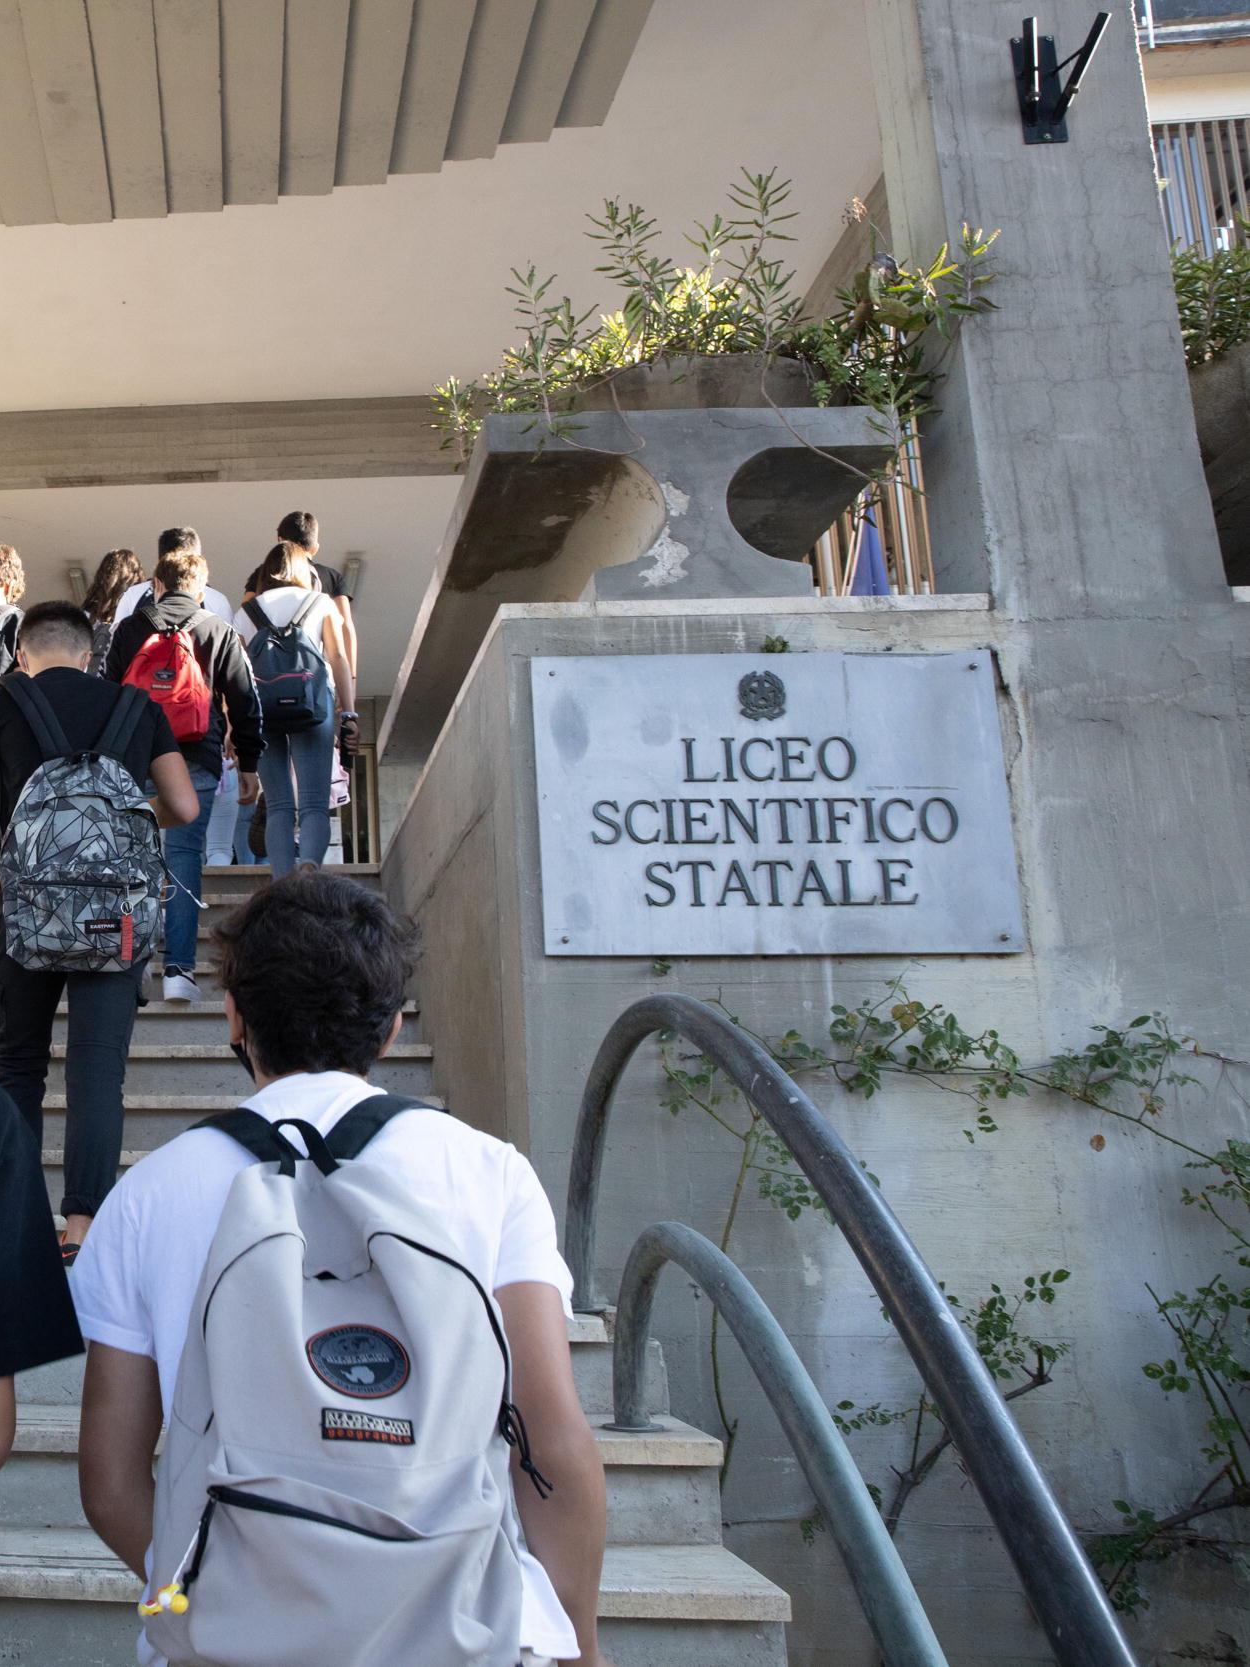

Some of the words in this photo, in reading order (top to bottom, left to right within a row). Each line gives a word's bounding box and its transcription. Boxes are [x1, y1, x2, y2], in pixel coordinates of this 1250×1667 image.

[681, 736, 857, 783] LICEO
[591, 796, 960, 845] SCIENTIFICO
[645, 858, 920, 908] STATALE
